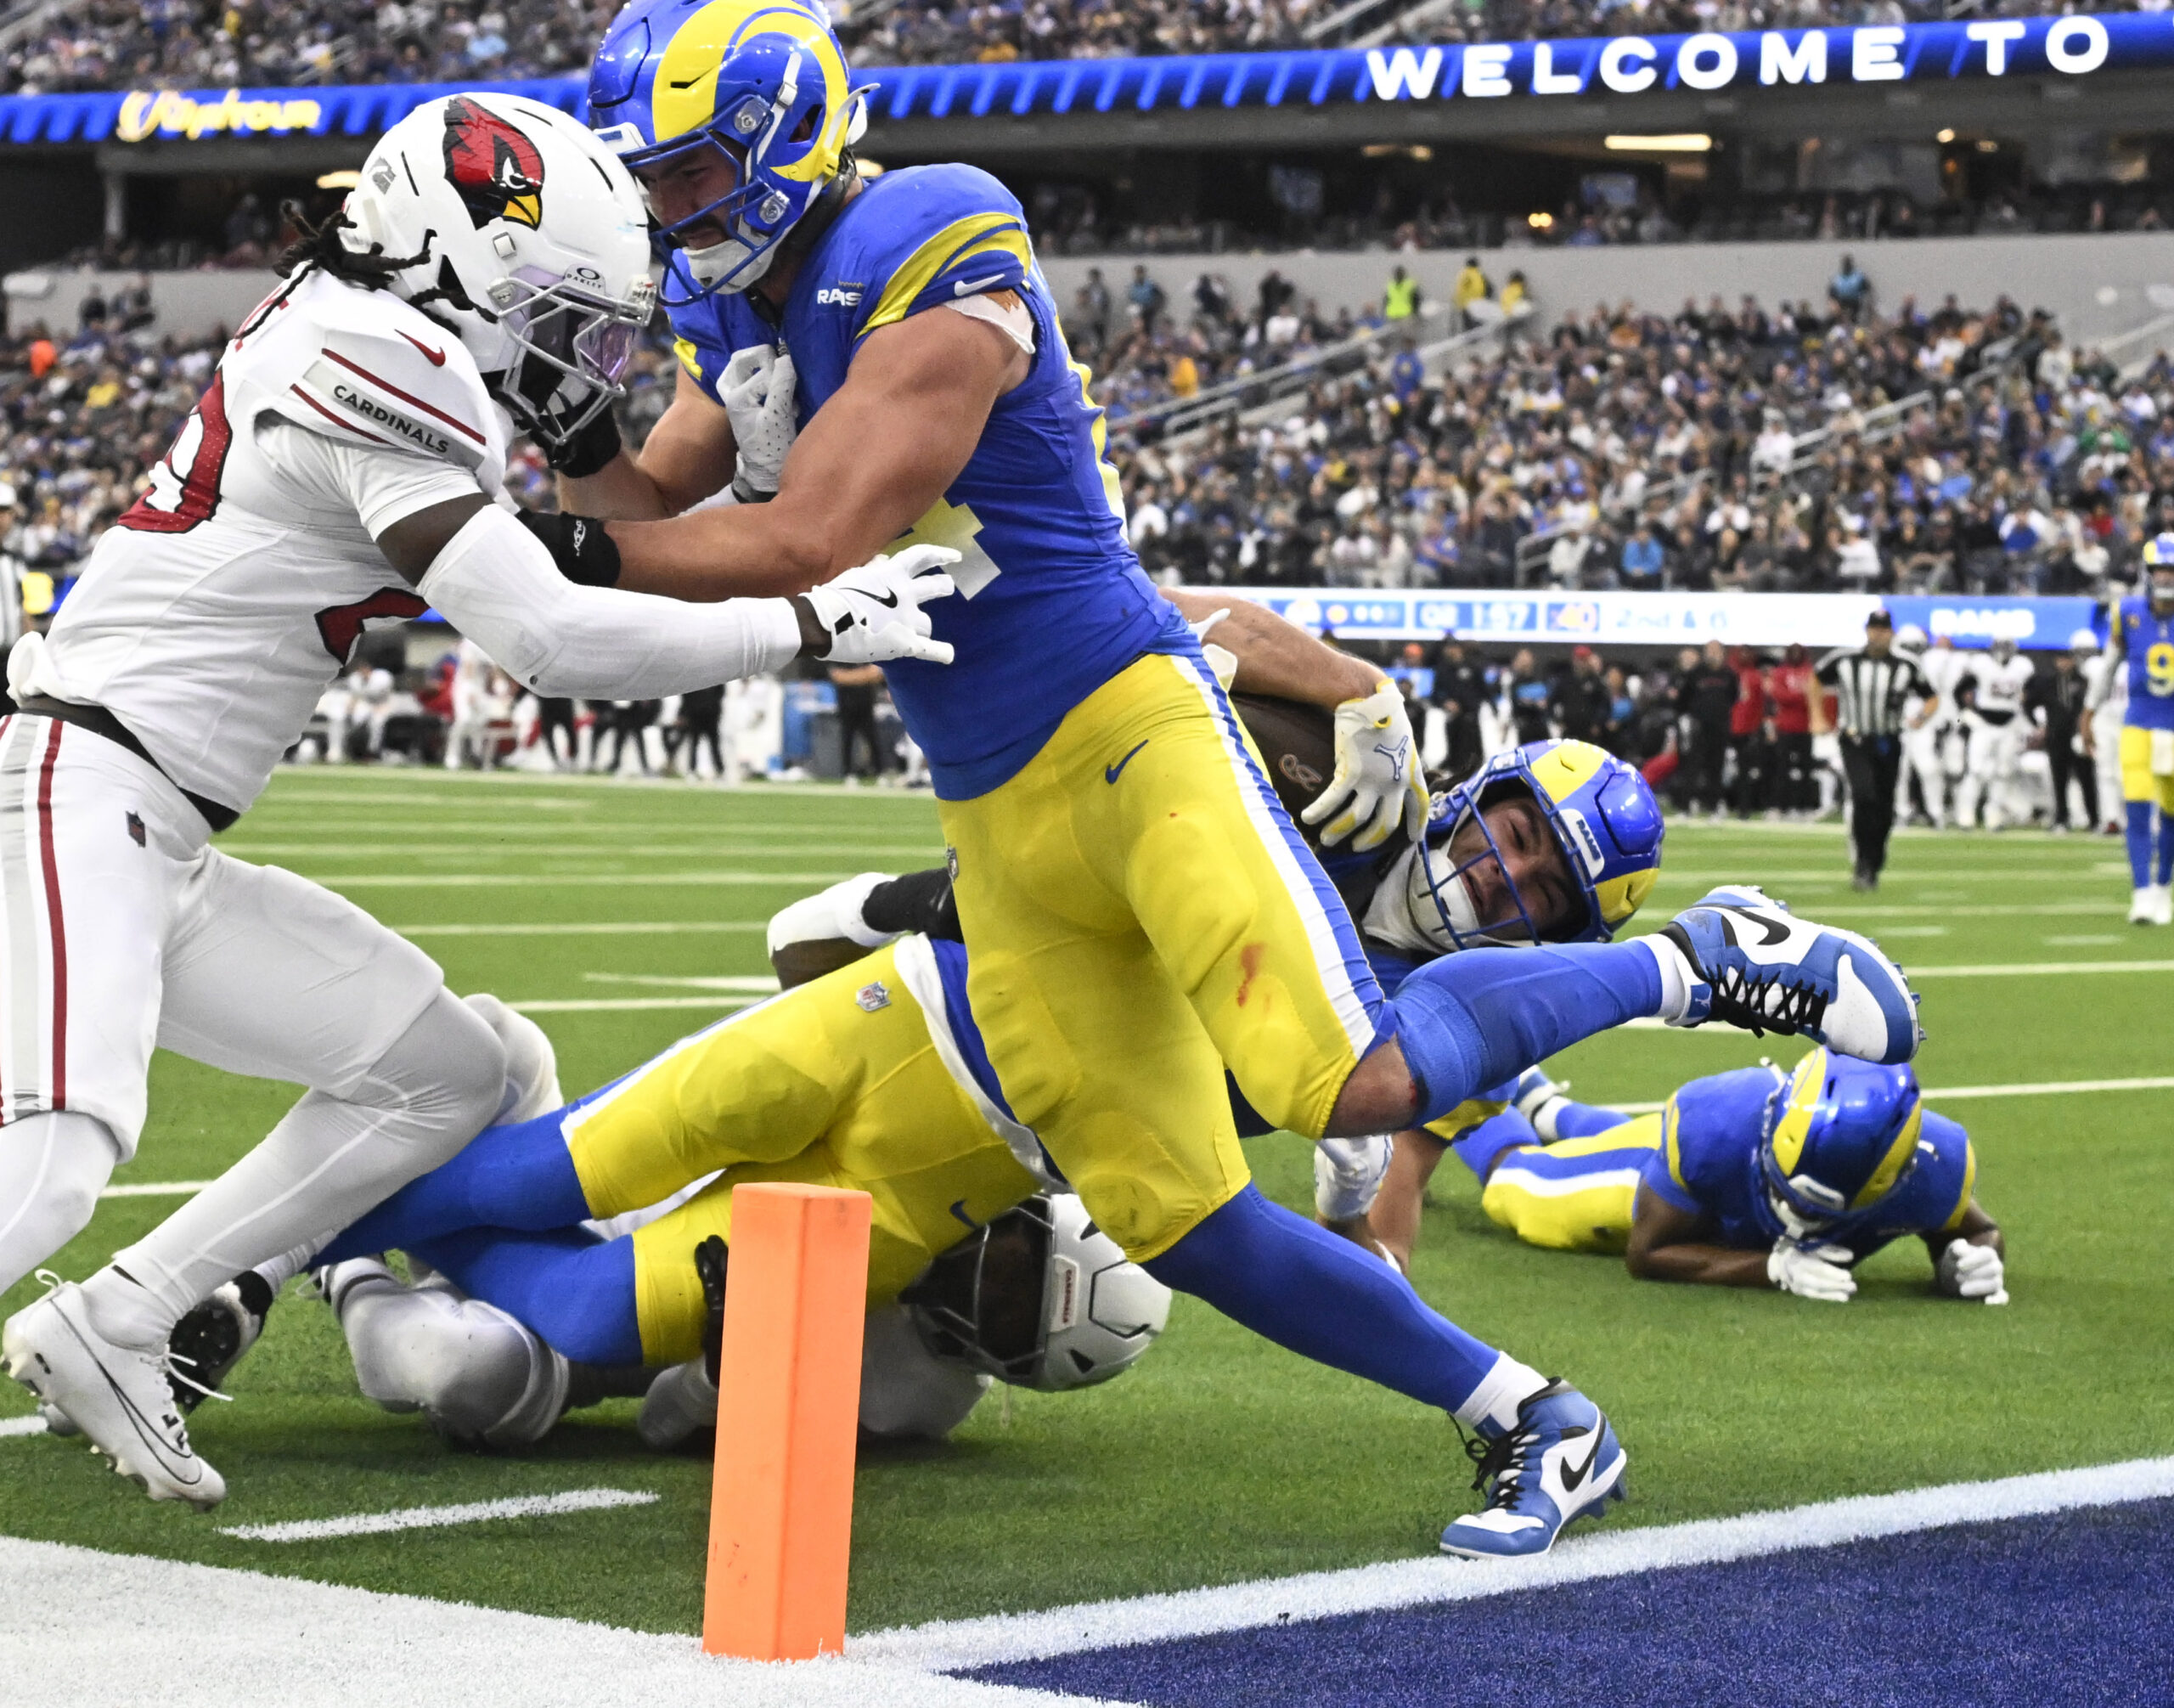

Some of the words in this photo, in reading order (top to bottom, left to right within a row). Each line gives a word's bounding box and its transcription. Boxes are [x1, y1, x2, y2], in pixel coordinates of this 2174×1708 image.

[1366, 26, 1906, 101] WELCOME
[1966, 15, 2109, 75] TO
[334, 385, 449, 453] CARDINALS
